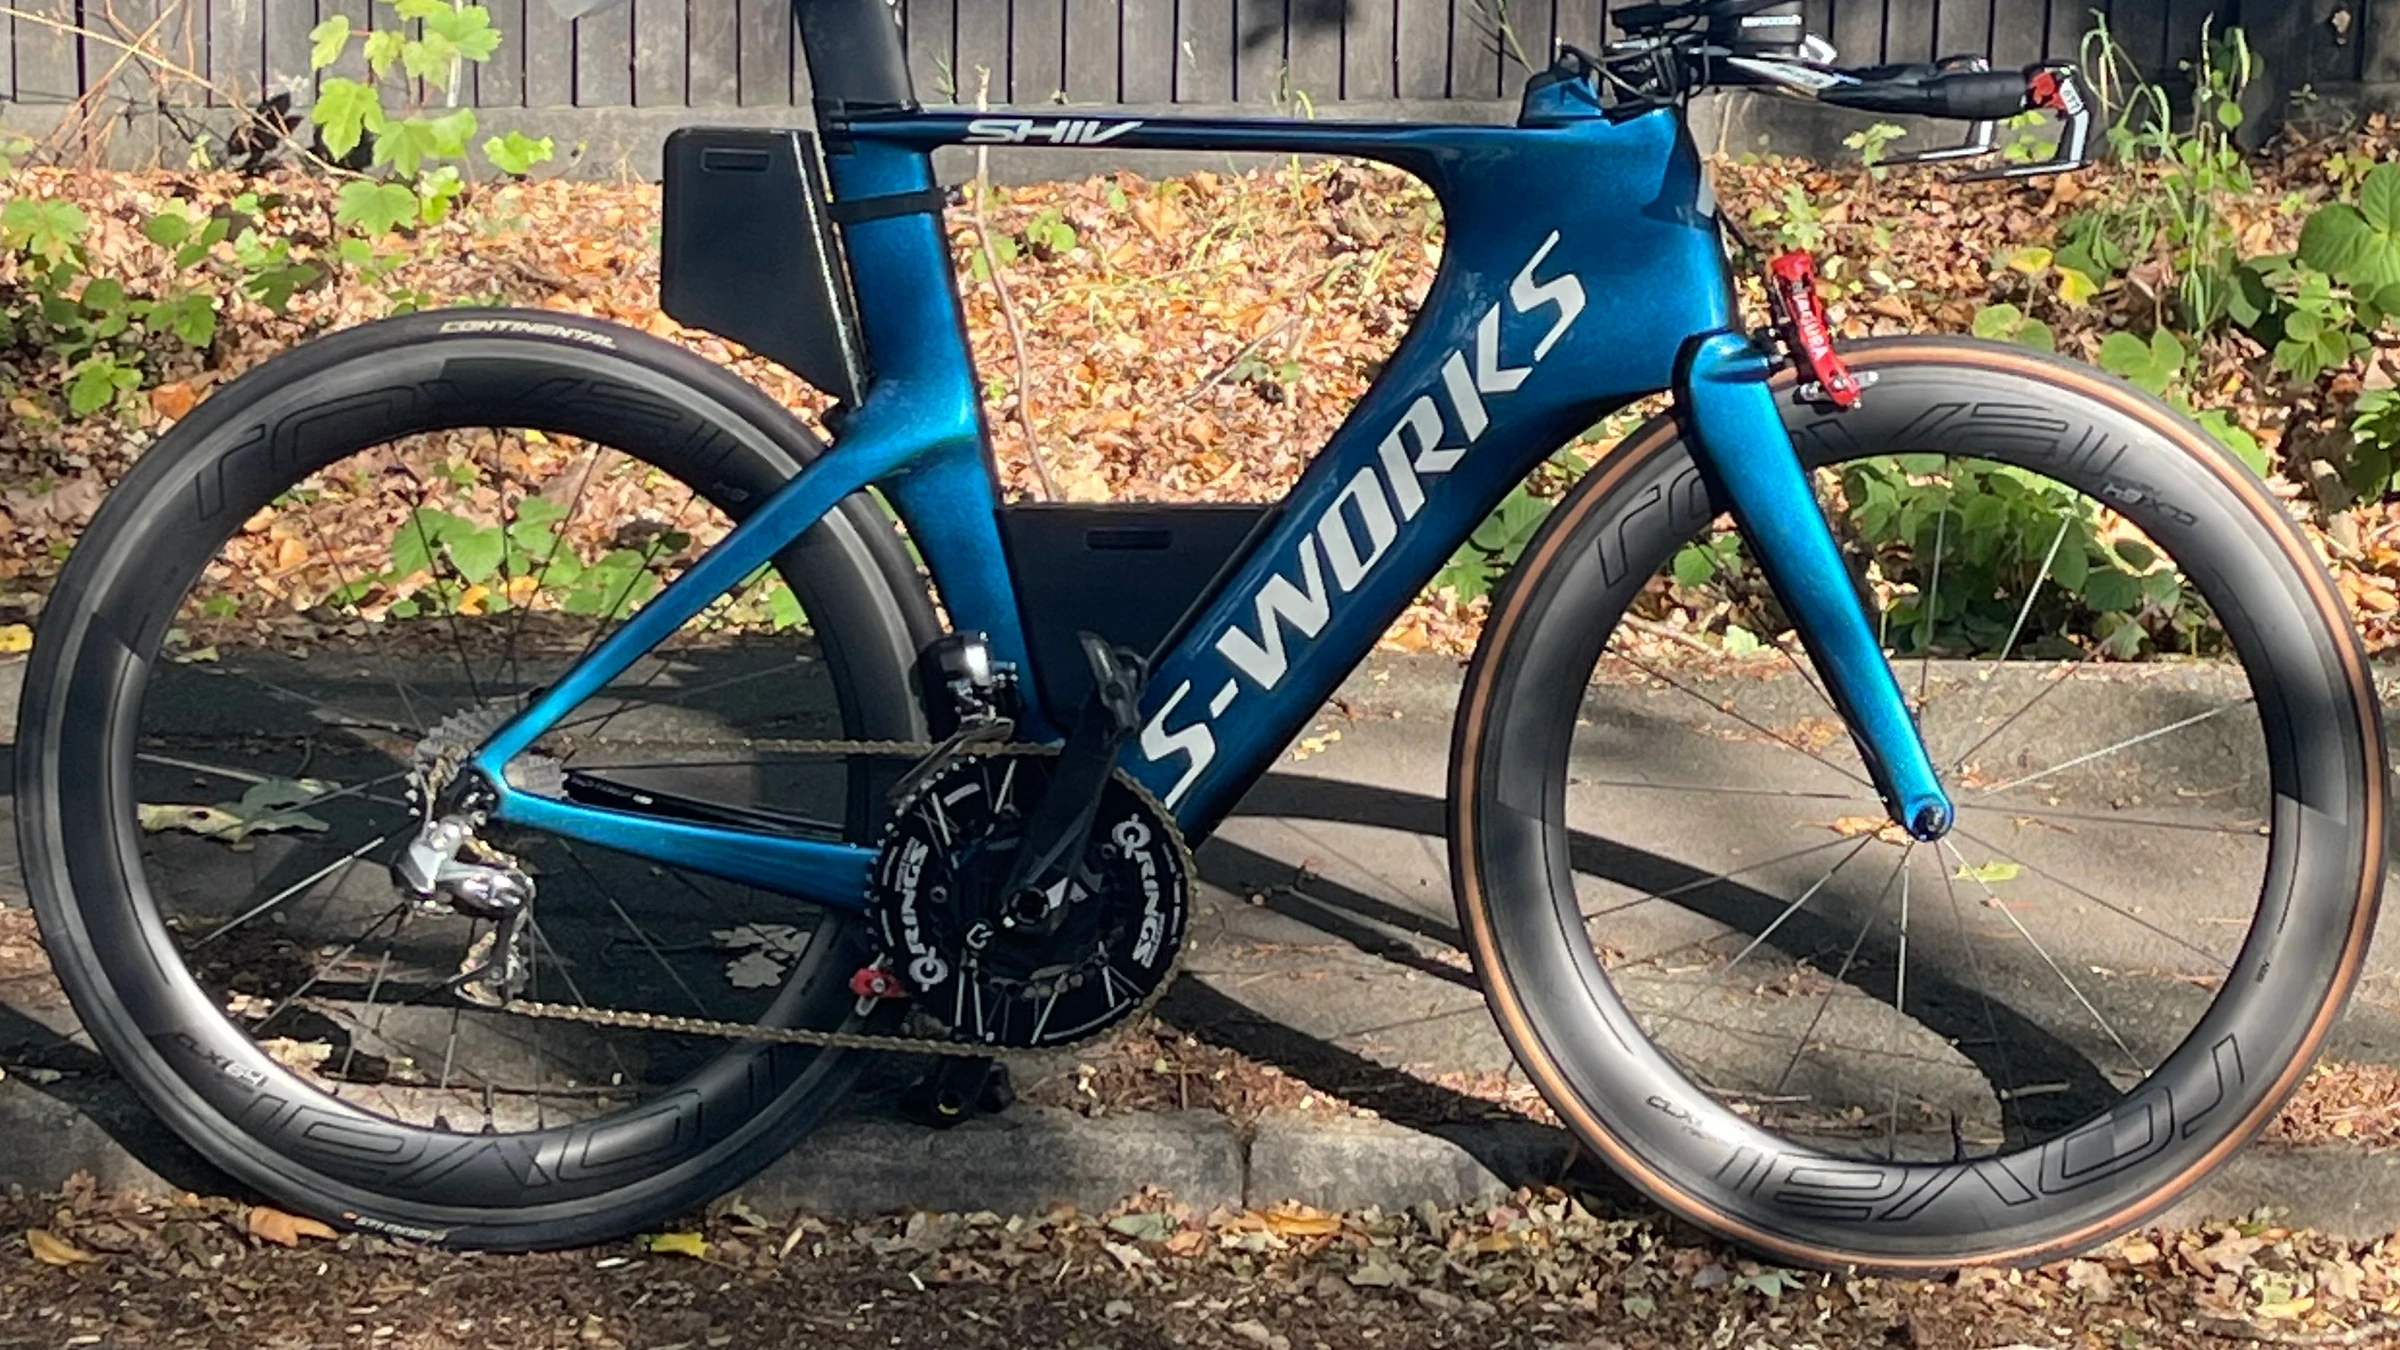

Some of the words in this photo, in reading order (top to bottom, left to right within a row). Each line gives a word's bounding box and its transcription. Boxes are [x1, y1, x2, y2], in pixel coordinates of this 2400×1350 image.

[962, 119, 1144, 143] SHIV
[439, 320, 617, 349] CONTINENTAL
[1140, 229, 1587, 809] S-WORKS
